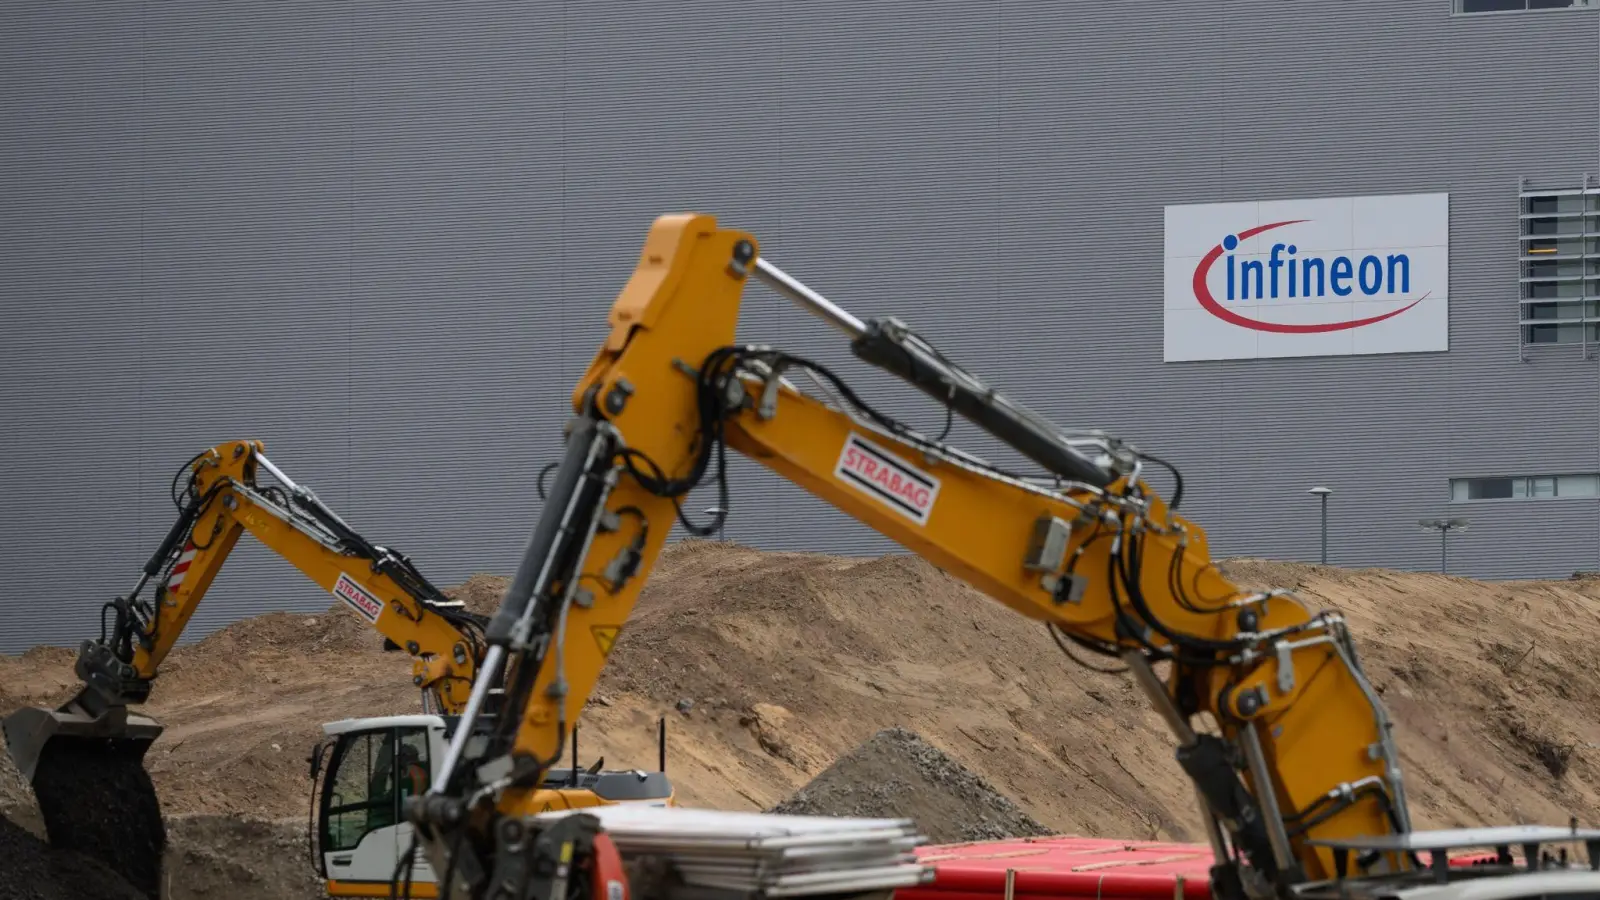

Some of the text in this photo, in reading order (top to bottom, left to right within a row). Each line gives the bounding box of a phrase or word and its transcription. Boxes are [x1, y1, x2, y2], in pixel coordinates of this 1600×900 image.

[1222, 234, 1409, 300] infineon
[844, 447, 930, 509] STRABAG
[337, 580, 379, 615] STRABAG
